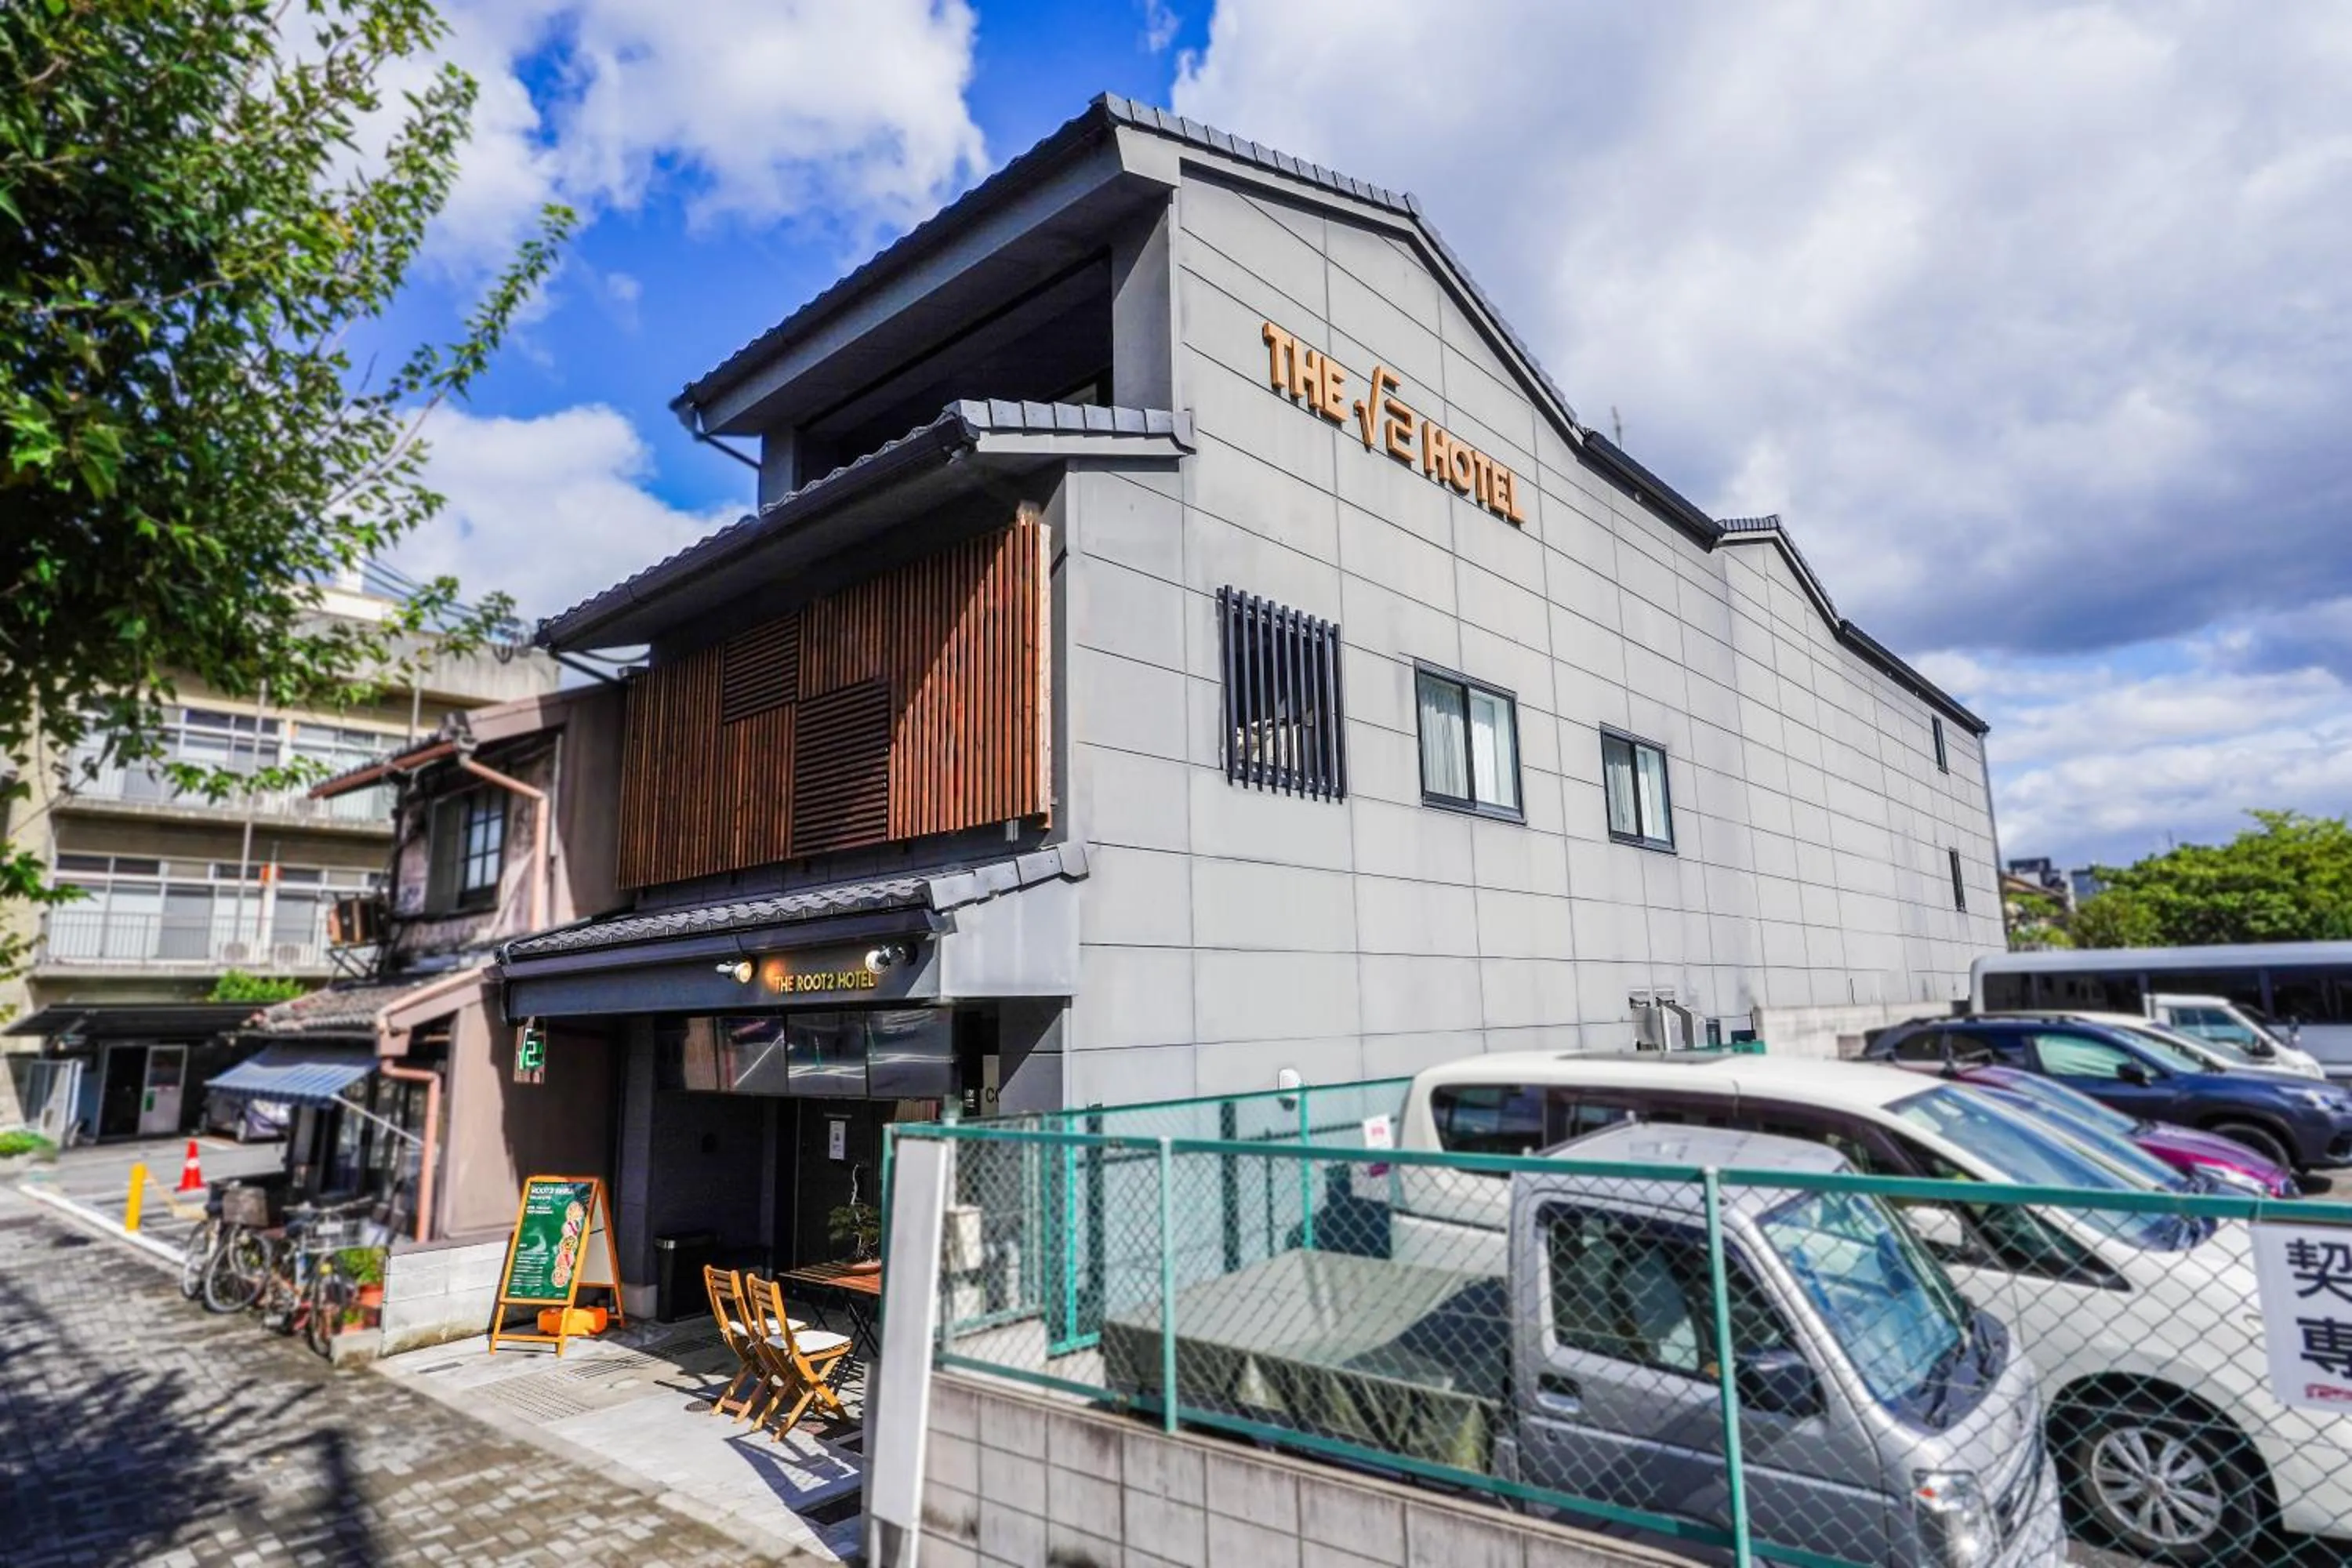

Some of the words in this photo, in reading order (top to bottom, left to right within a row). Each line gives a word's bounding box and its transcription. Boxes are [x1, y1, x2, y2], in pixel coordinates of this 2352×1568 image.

[1263, 321, 1346, 424] THE
[1421, 420, 1526, 524] HOTEL
[774, 975, 795, 993] THE
[796, 973, 835, 991] ROOT2
[838, 970, 875, 988] HOTEL
